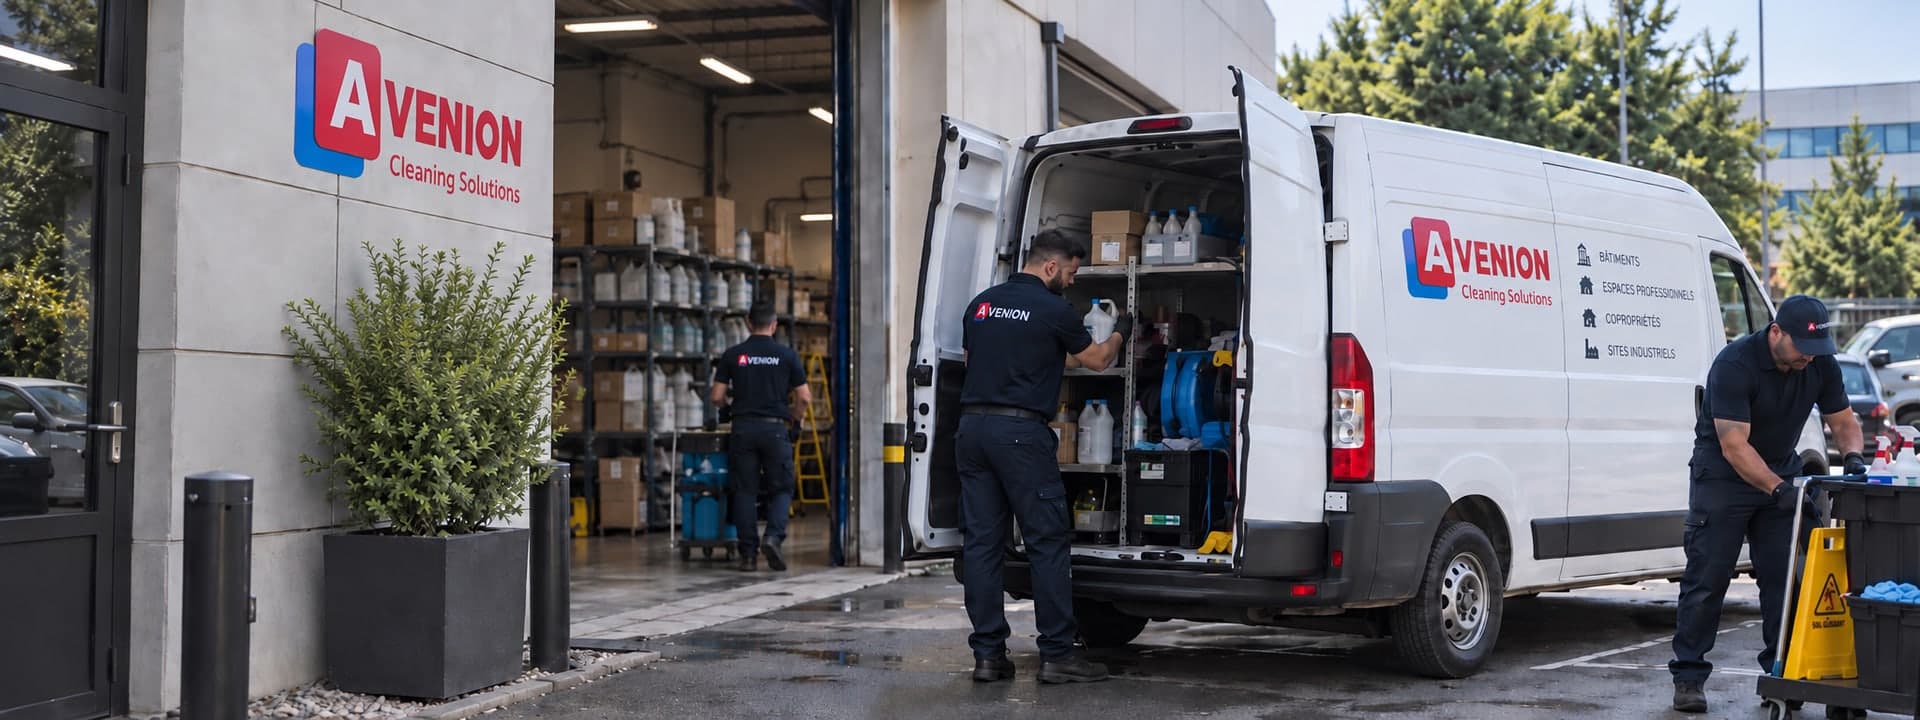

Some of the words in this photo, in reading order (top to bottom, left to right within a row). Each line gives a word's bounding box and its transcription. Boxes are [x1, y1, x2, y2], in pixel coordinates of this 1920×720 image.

[328, 58, 523, 168] AVENION
[389, 154, 455, 195] Cleaning
[459, 171, 521, 204] Solutions
[1424, 230, 1551, 282] AVENION
[1599, 250, 1641, 268] BÂTIMENTS
[1461, 284, 1506, 306] Cleaning
[1508, 289, 1553, 307] Solutions
[1602, 281, 1636, 296] ESPACES
[1636, 285, 1695, 301] PROFESSIONNELS
[977, 304, 1030, 322] AVENION
[1605, 312, 1662, 328] COPROPRIÉTÉS
[1607, 344, 1629, 358] SITES
[1630, 346, 1677, 360] INDUSTRIELS
